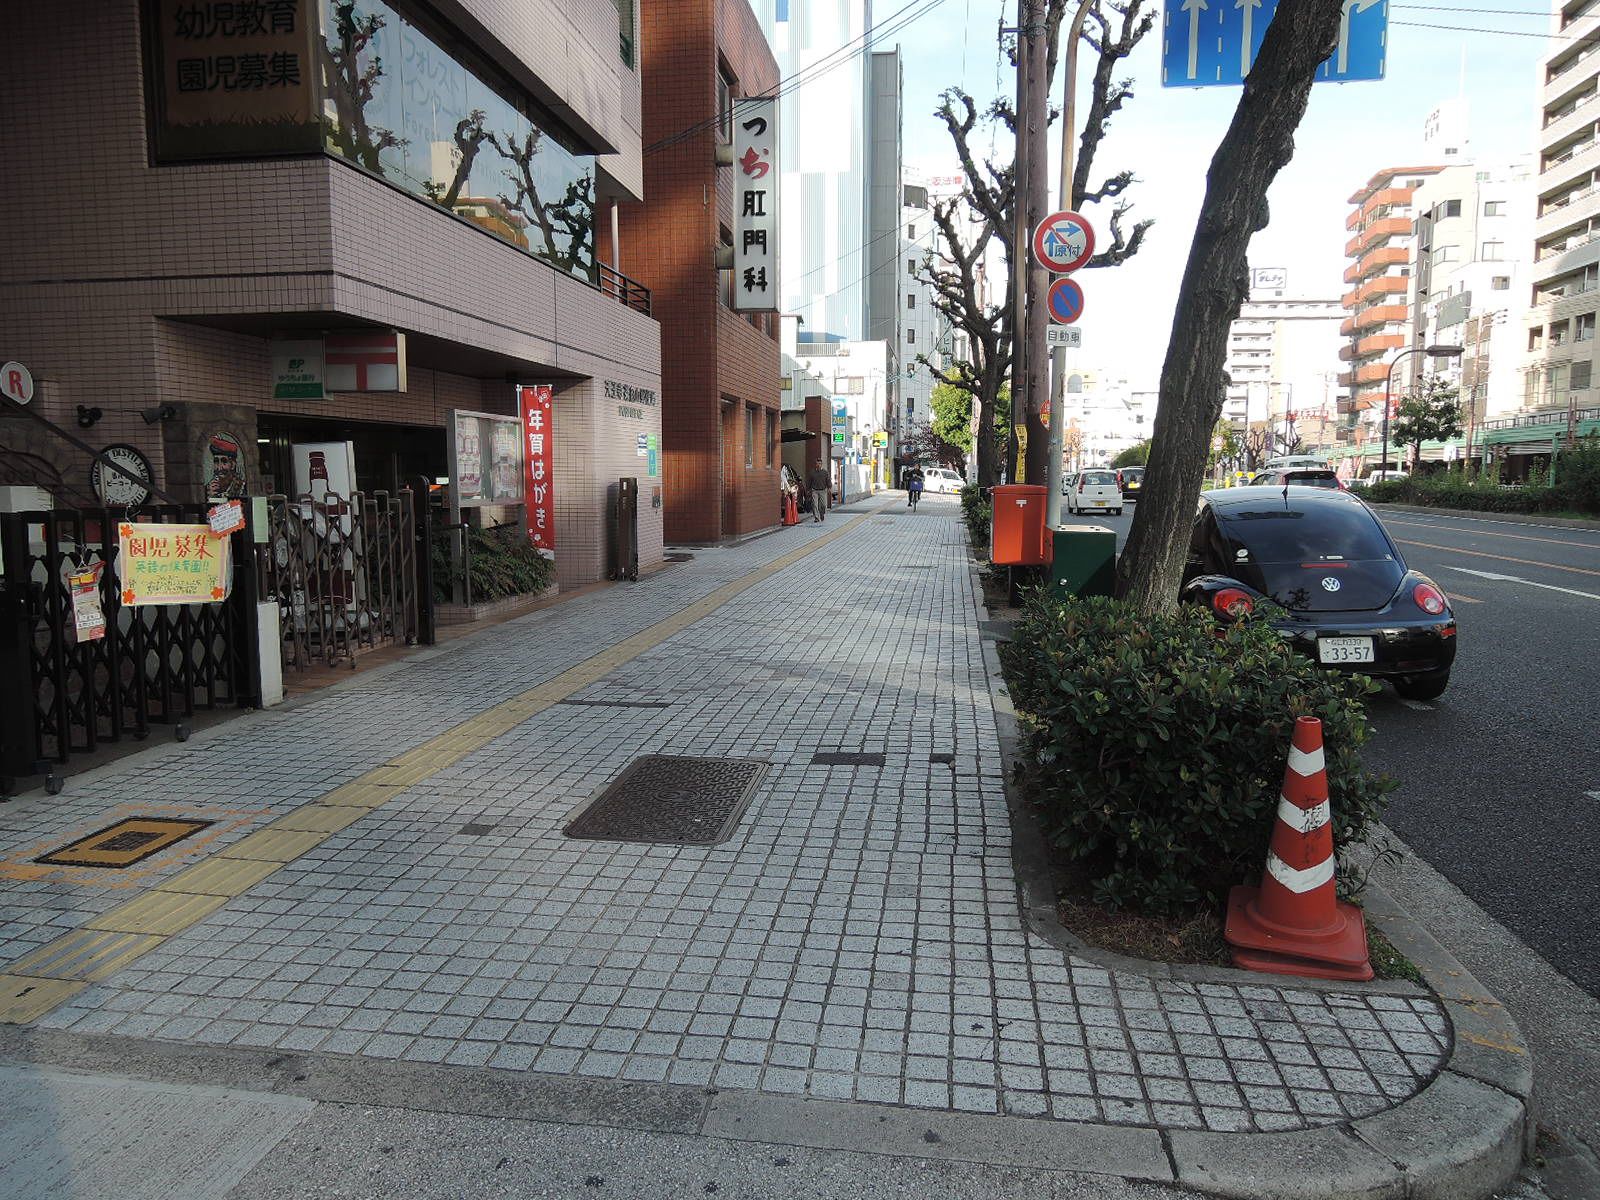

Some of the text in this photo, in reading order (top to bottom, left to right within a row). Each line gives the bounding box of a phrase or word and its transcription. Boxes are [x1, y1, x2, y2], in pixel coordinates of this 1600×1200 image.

[174, 0, 298, 39] 幼児教育
[177, 51, 300, 92] 園児募集
[739, 117, 769, 292] つぢ肛門科
[1055, 244, 1080, 257] 原付
[1048, 330, 1080, 343] 自動車
[9, 370, 26, 399] R
[528, 408, 548, 529] 年賀はがき
[1332, 647, 1370, 660] 33-57
